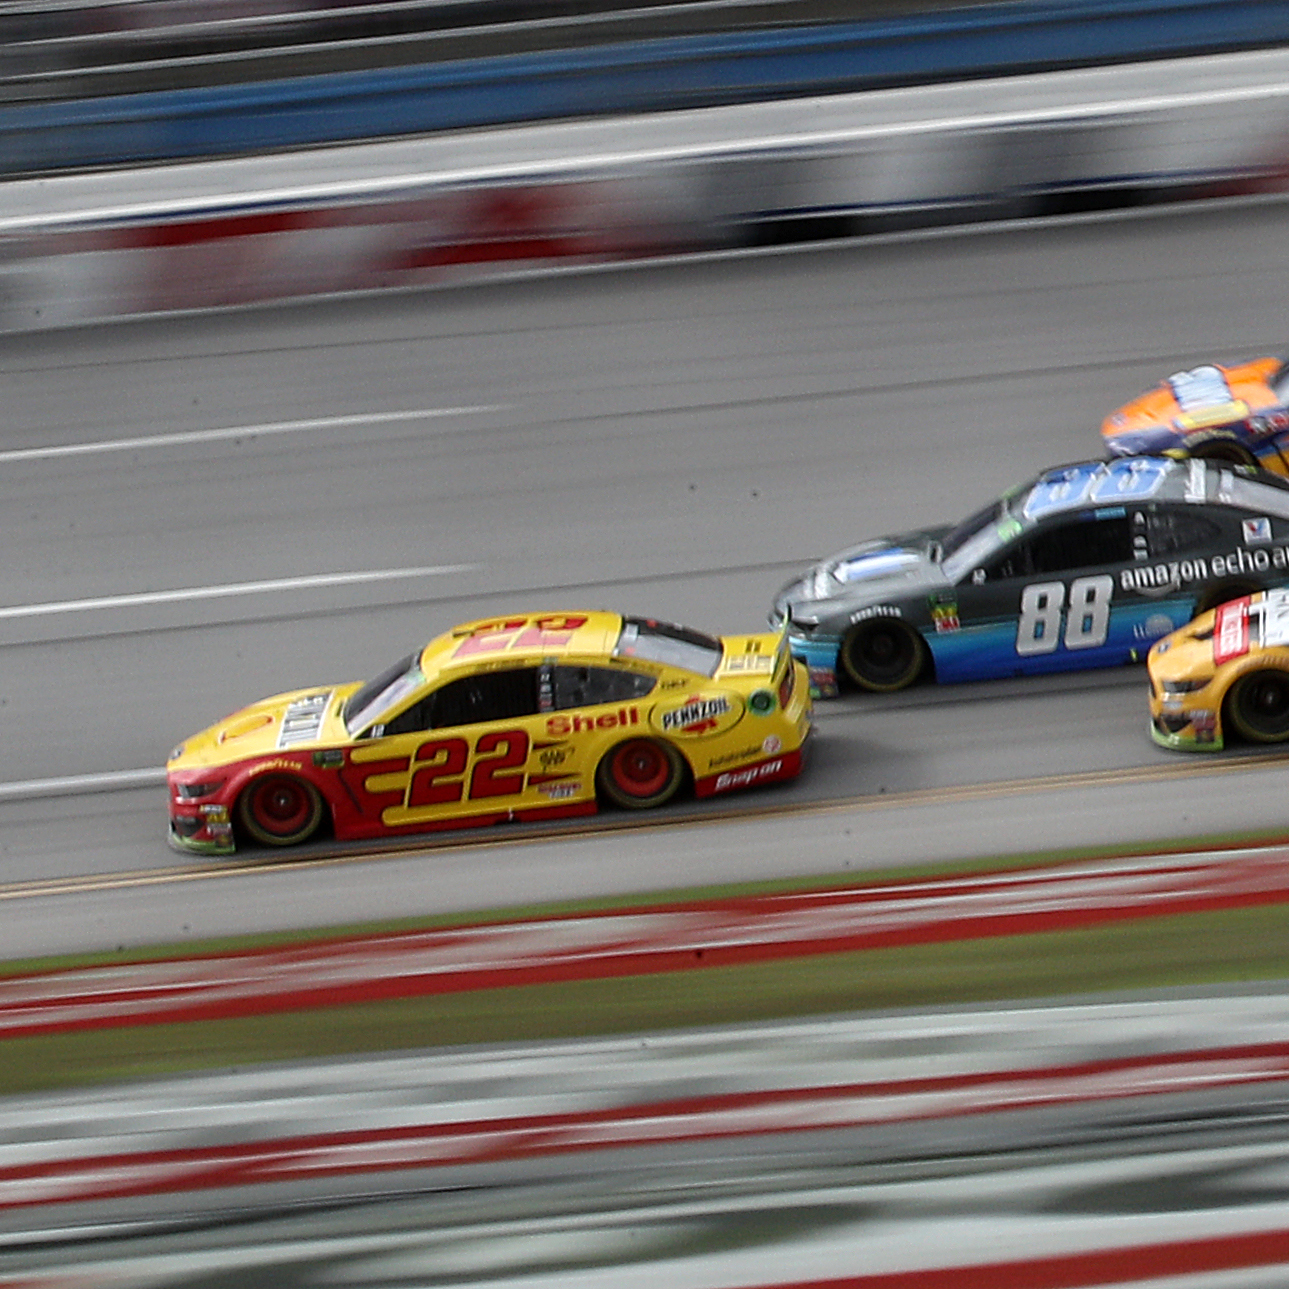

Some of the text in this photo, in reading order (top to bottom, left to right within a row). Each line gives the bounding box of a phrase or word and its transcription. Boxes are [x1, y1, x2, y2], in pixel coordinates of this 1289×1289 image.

[1121, 557, 1209, 591] amazon
[1212, 546, 1270, 577] echo
[1016, 574, 1114, 657] 88
[546, 707, 639, 736] Shell
[661, 696, 730, 730] PENNZOIL
[408, 730, 531, 808] 22
